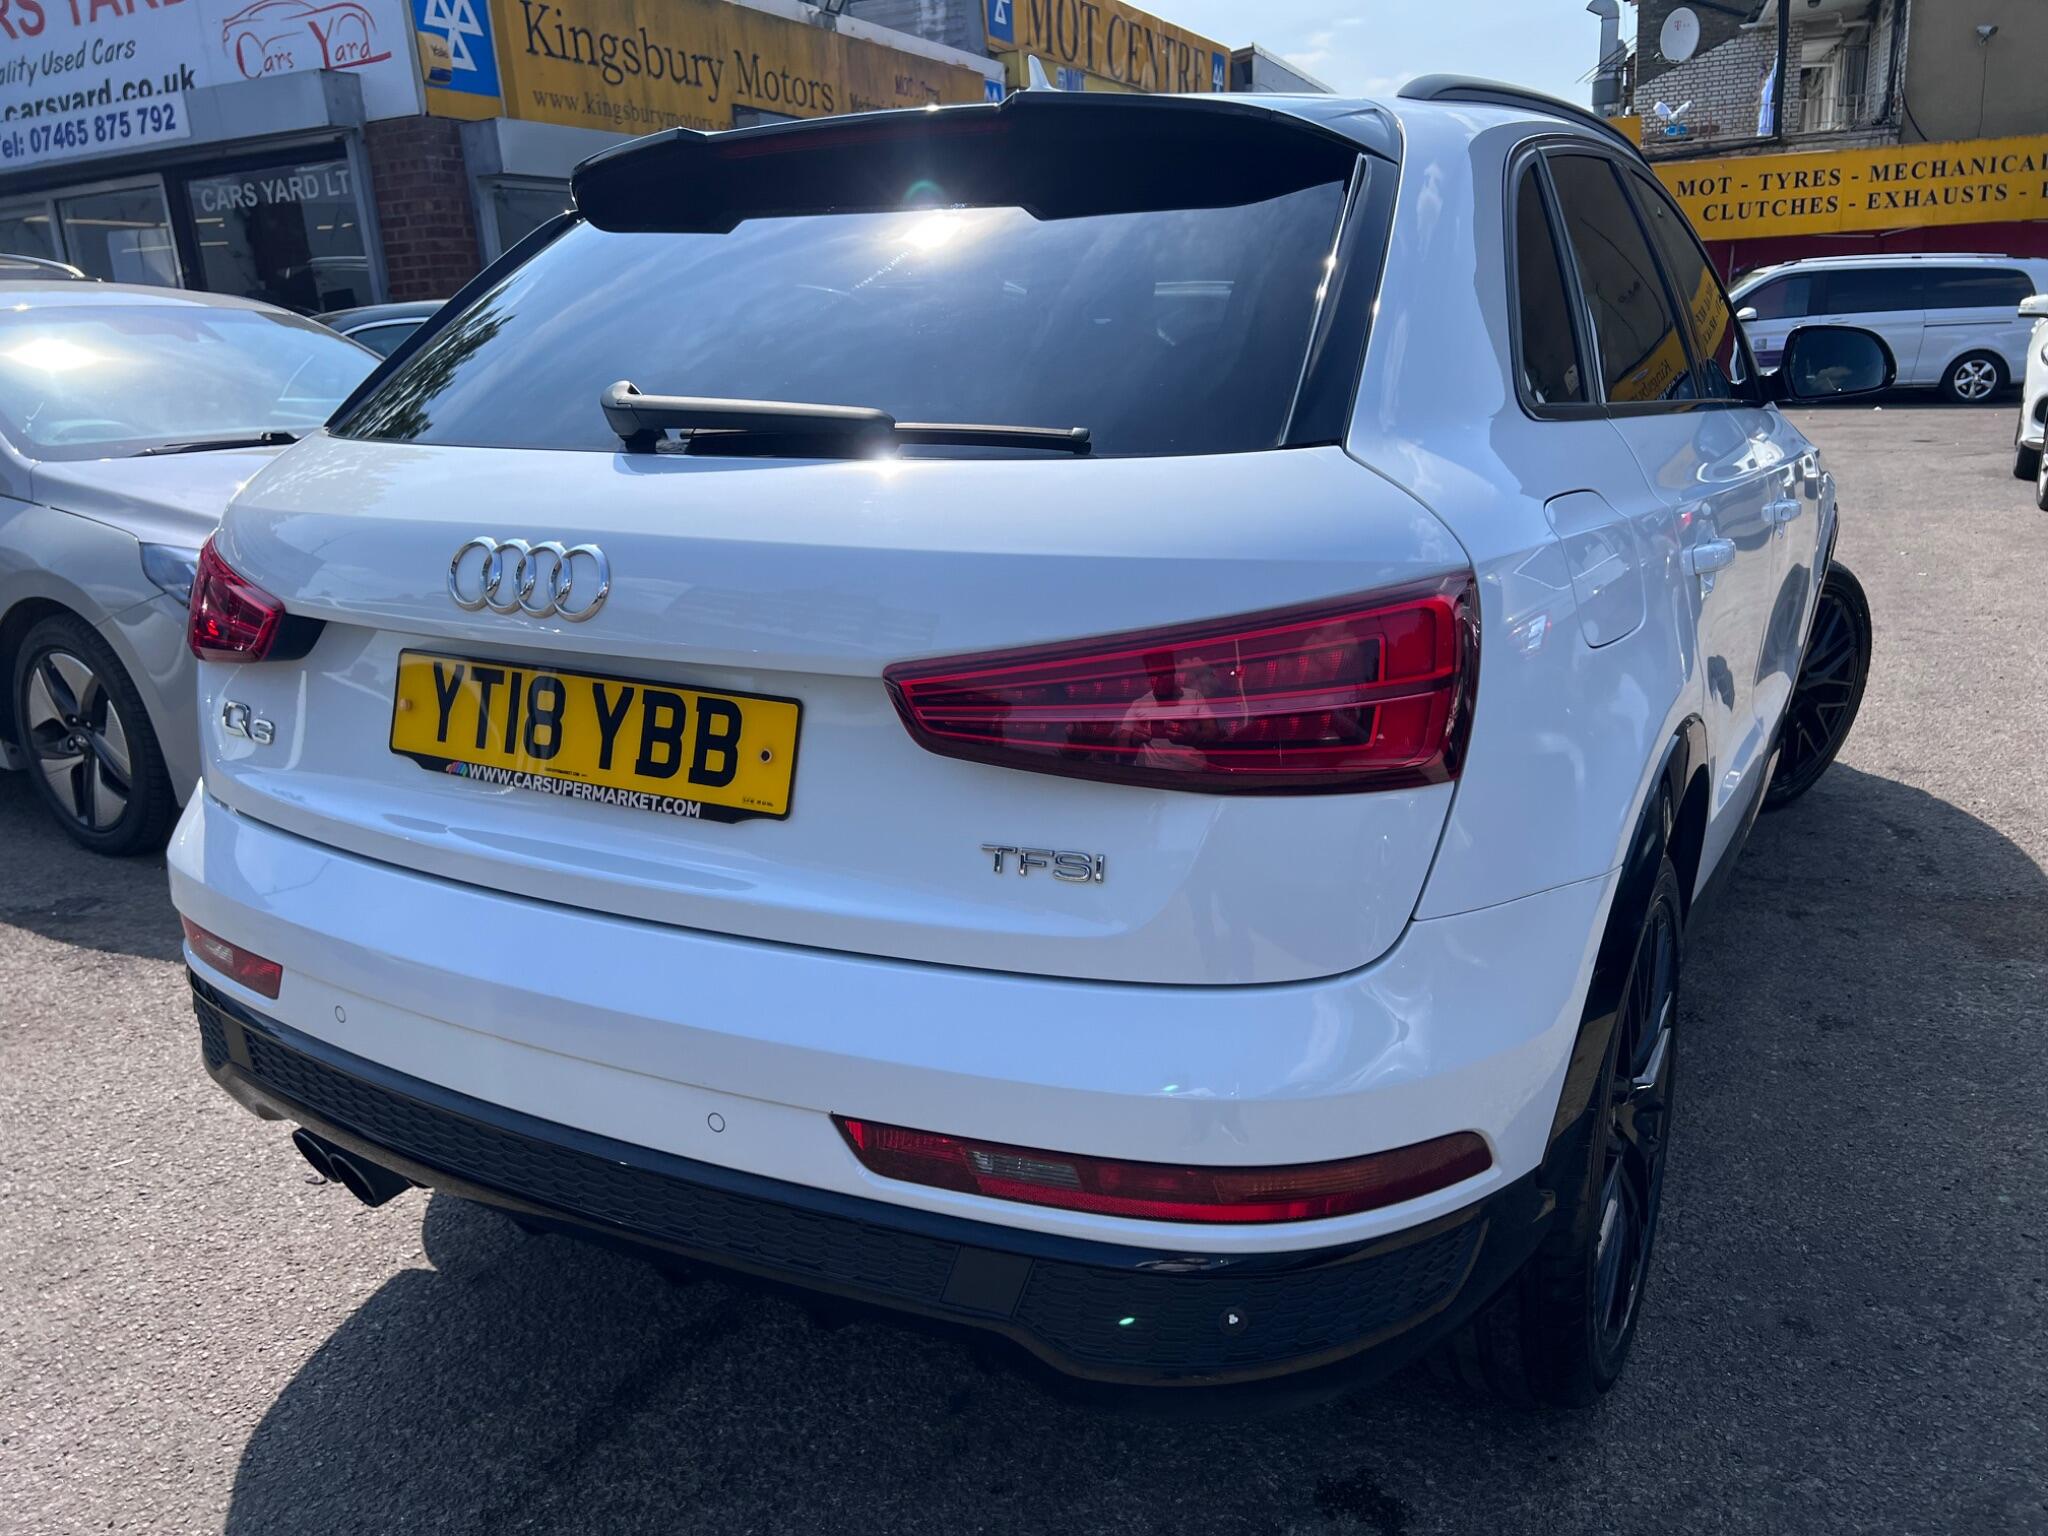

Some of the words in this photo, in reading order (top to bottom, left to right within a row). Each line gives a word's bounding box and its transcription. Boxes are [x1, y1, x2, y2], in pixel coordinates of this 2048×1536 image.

[42, 40, 87, 76] Used
[92, 38, 136, 66] Cars
[236, 32, 294, 80] Cars
[519, 0, 724, 102] Kingsbury
[734, 50, 835, 112] Motors
[1026, 0, 1099, 70] MOT
[1106, 14, 1204, 93] CENTRE
[0, 131, 24, 158] el:
[30, 118, 89, 153] 07465
[94, 111, 132, 143] 875
[137, 103, 177, 135] 792
[201, 182, 258, 212] CARS
[260, 174, 319, 204] YARD
[325, 170, 350, 196] LT
[1675, 176, 1733, 198] MOT
[1759, 168, 1842, 191] TYRES
[1702, 196, 1839, 222] CLUTCHES
[1866, 183, 2008, 211] EXHAUSTS
[222, 700, 276, 745] Q3
[432, 661, 567, 761] YT18
[592, 682, 743, 788] YBB
[469, 763, 702, 819] WWW.CARSUPERMARKET.COM
[981, 843, 1105, 884] TFSI
